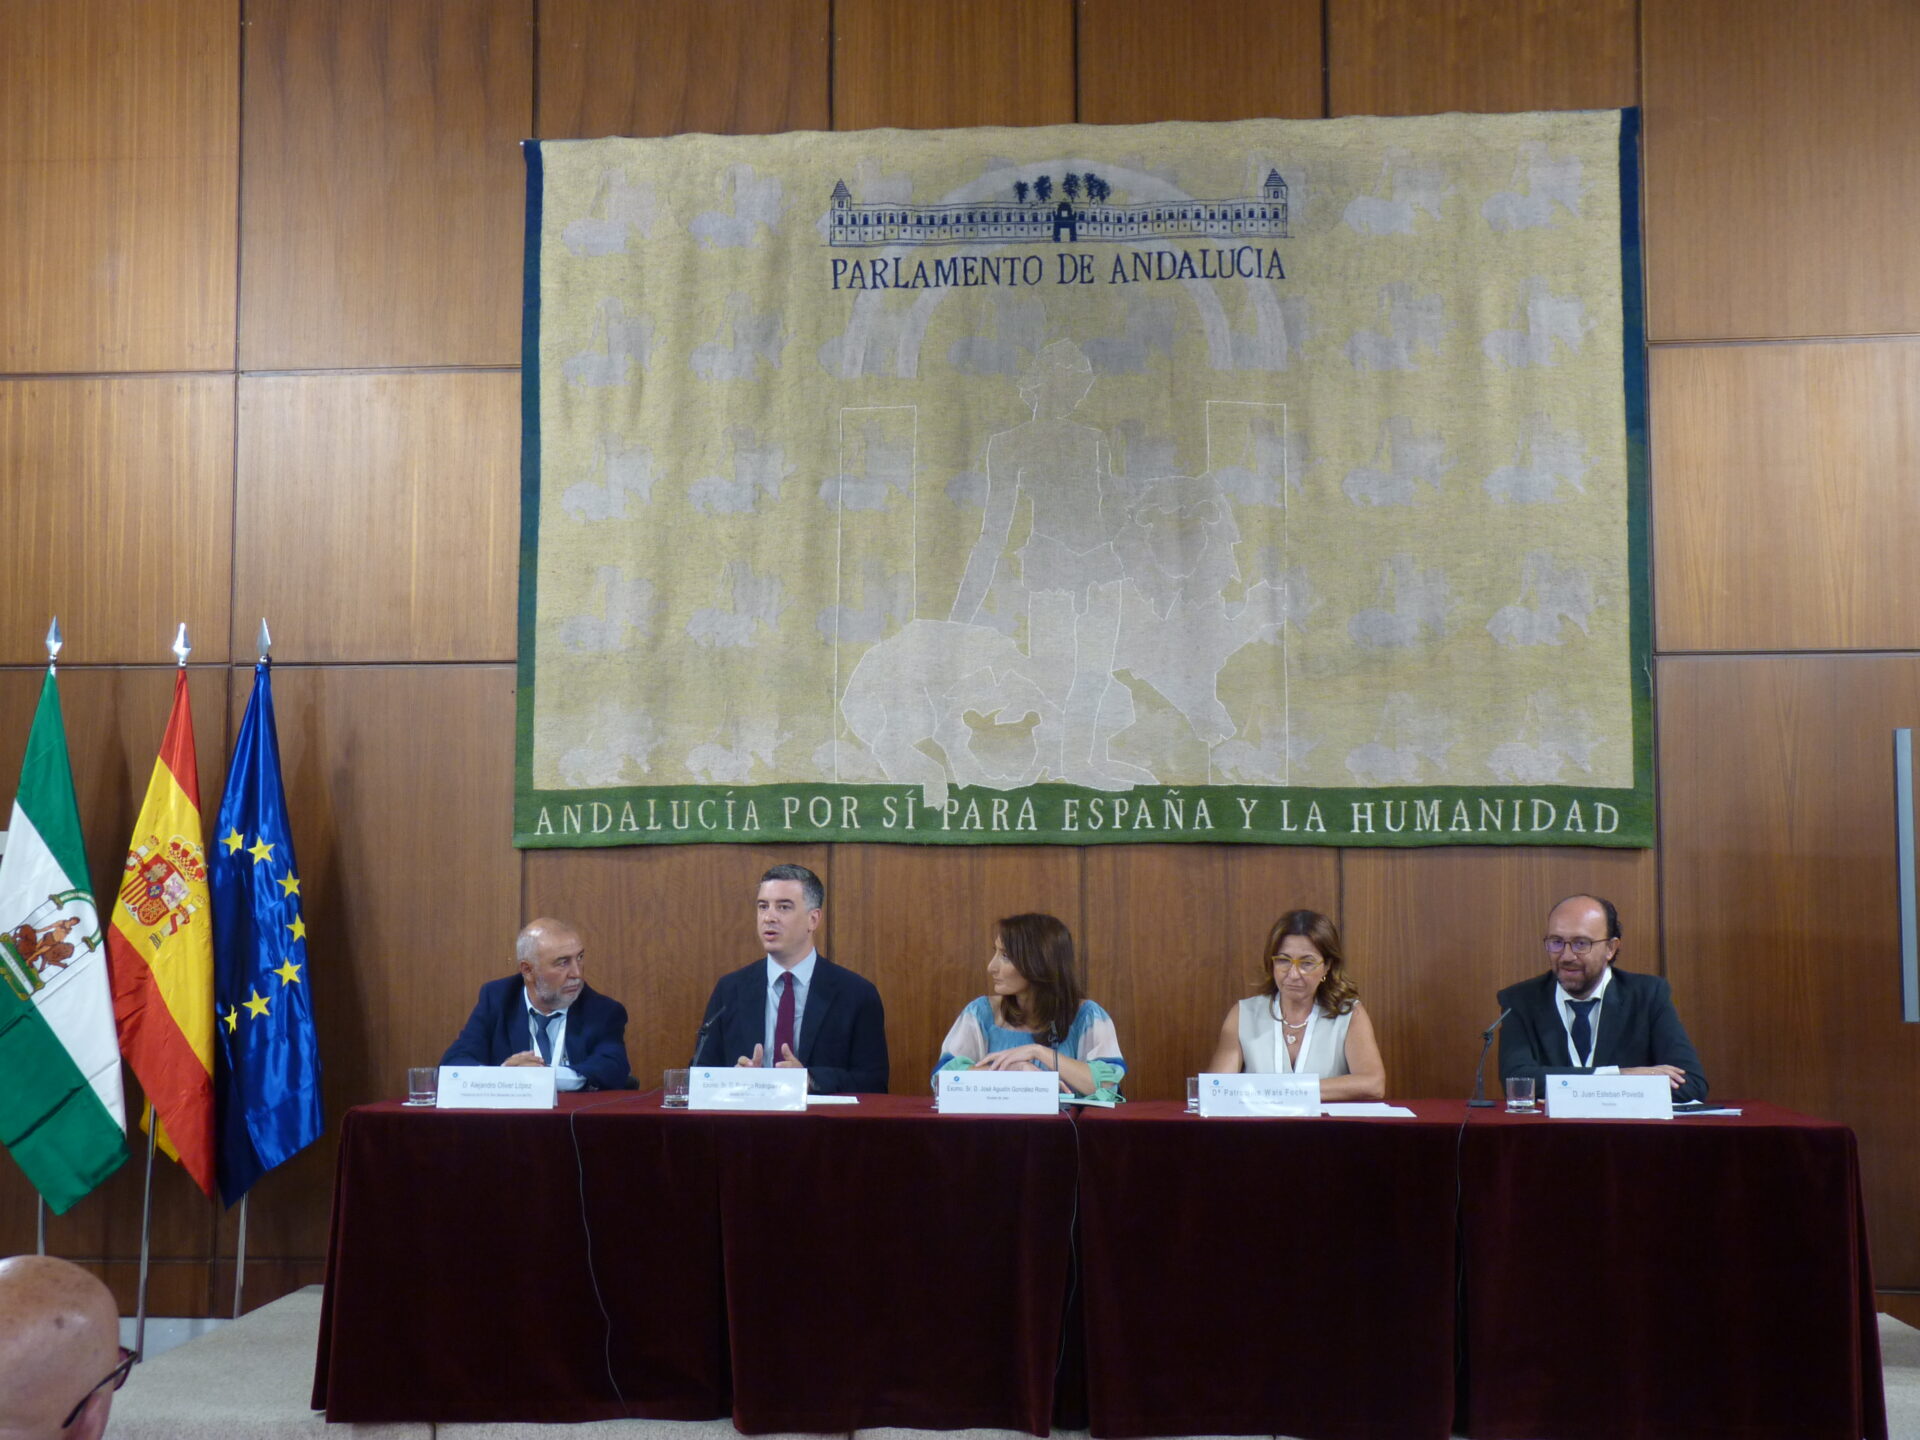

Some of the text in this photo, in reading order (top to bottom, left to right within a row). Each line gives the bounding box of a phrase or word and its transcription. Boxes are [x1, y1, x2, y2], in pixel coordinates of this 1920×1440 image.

[831, 246, 1286, 290] PARLAMENTO DE ANDALUCIA
[533, 790, 1620, 835] ANDALUCÍA POR SÍ PARA ESPAÑA Y LA HUMANIDAD
